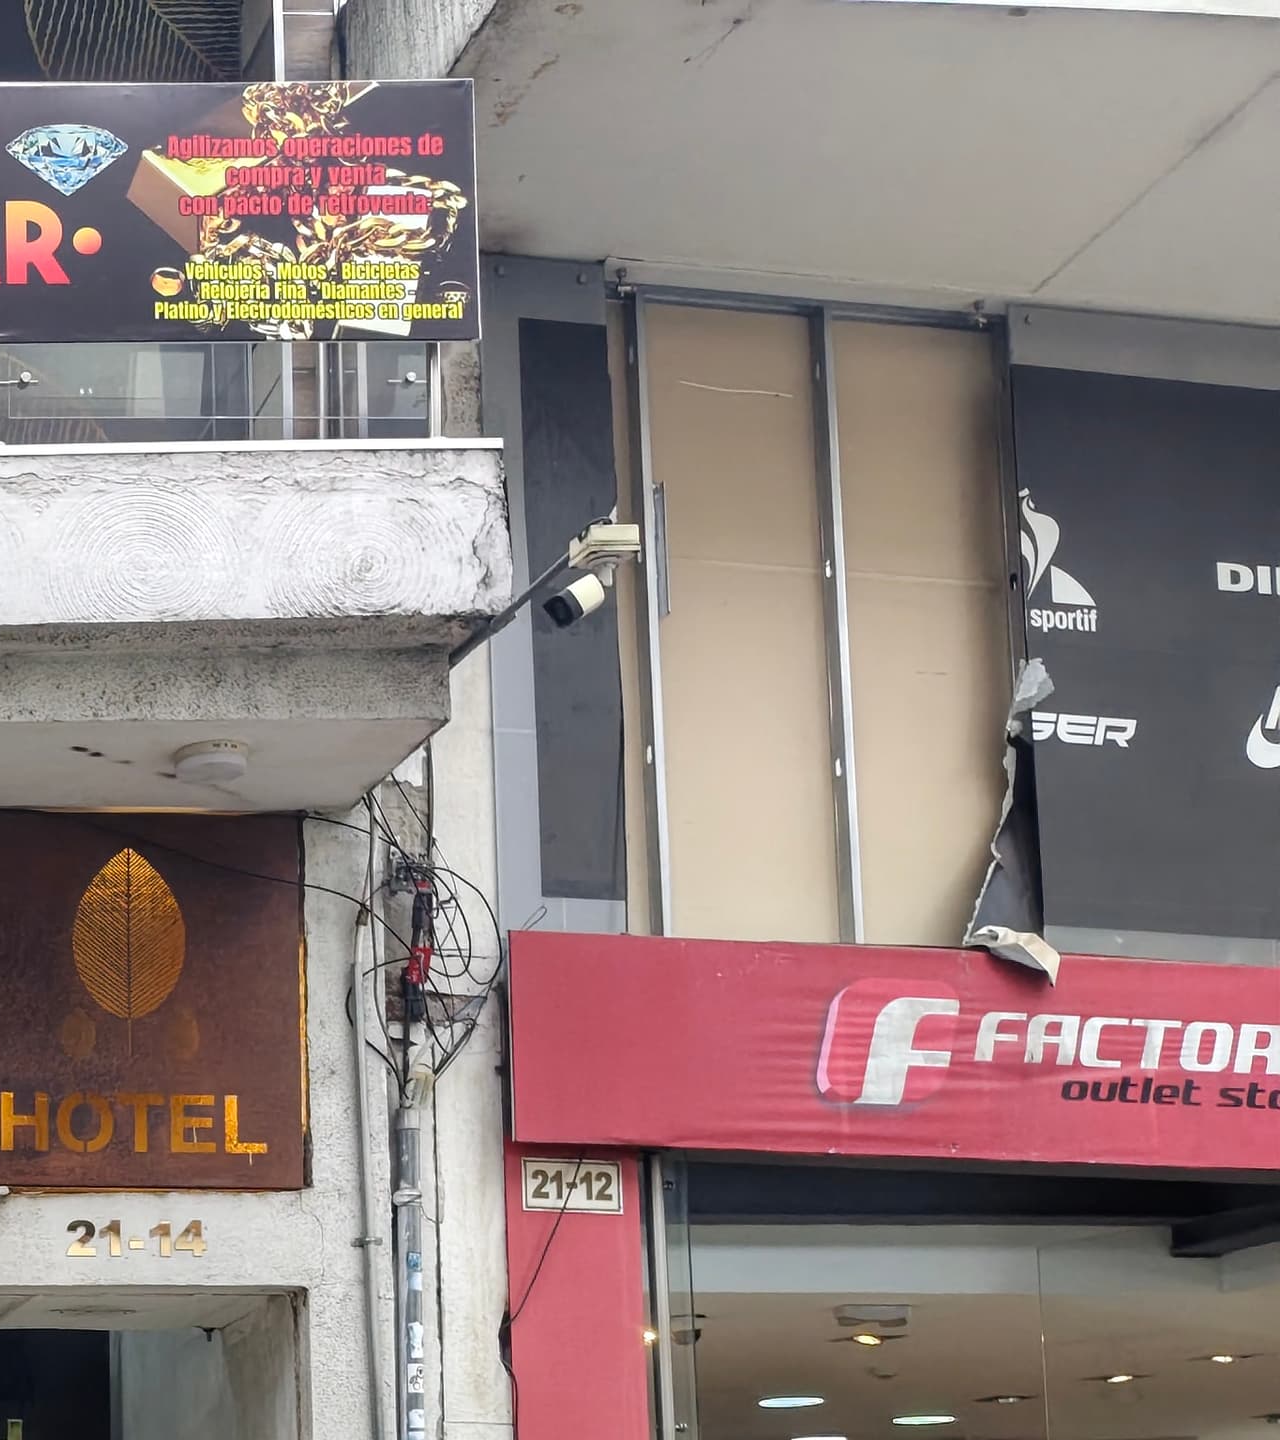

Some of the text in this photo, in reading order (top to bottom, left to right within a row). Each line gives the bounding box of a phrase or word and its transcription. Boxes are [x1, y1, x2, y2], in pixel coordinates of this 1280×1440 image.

[167, 131, 444, 158] Agilizamos operaciones de
[225, 163, 387, 188] compra venta
[179, 193, 315, 217] con pacto de
[184, 260, 420, 281] Vehículos Motos Bicicletas
[274, 281, 307, 300] Fina
[320, 280, 405, 300] Diamantes
[154, 300, 464, 322] Platino Electrodomésticos en general
[1030, 607, 1099, 633] sportif
[1060, 1077, 1202, 1106] outlet
[0, 1091, 269, 1154] HOTEL
[531, 1169, 613, 1201] 21-12
[66, 1218, 209, 1258] 21-14
